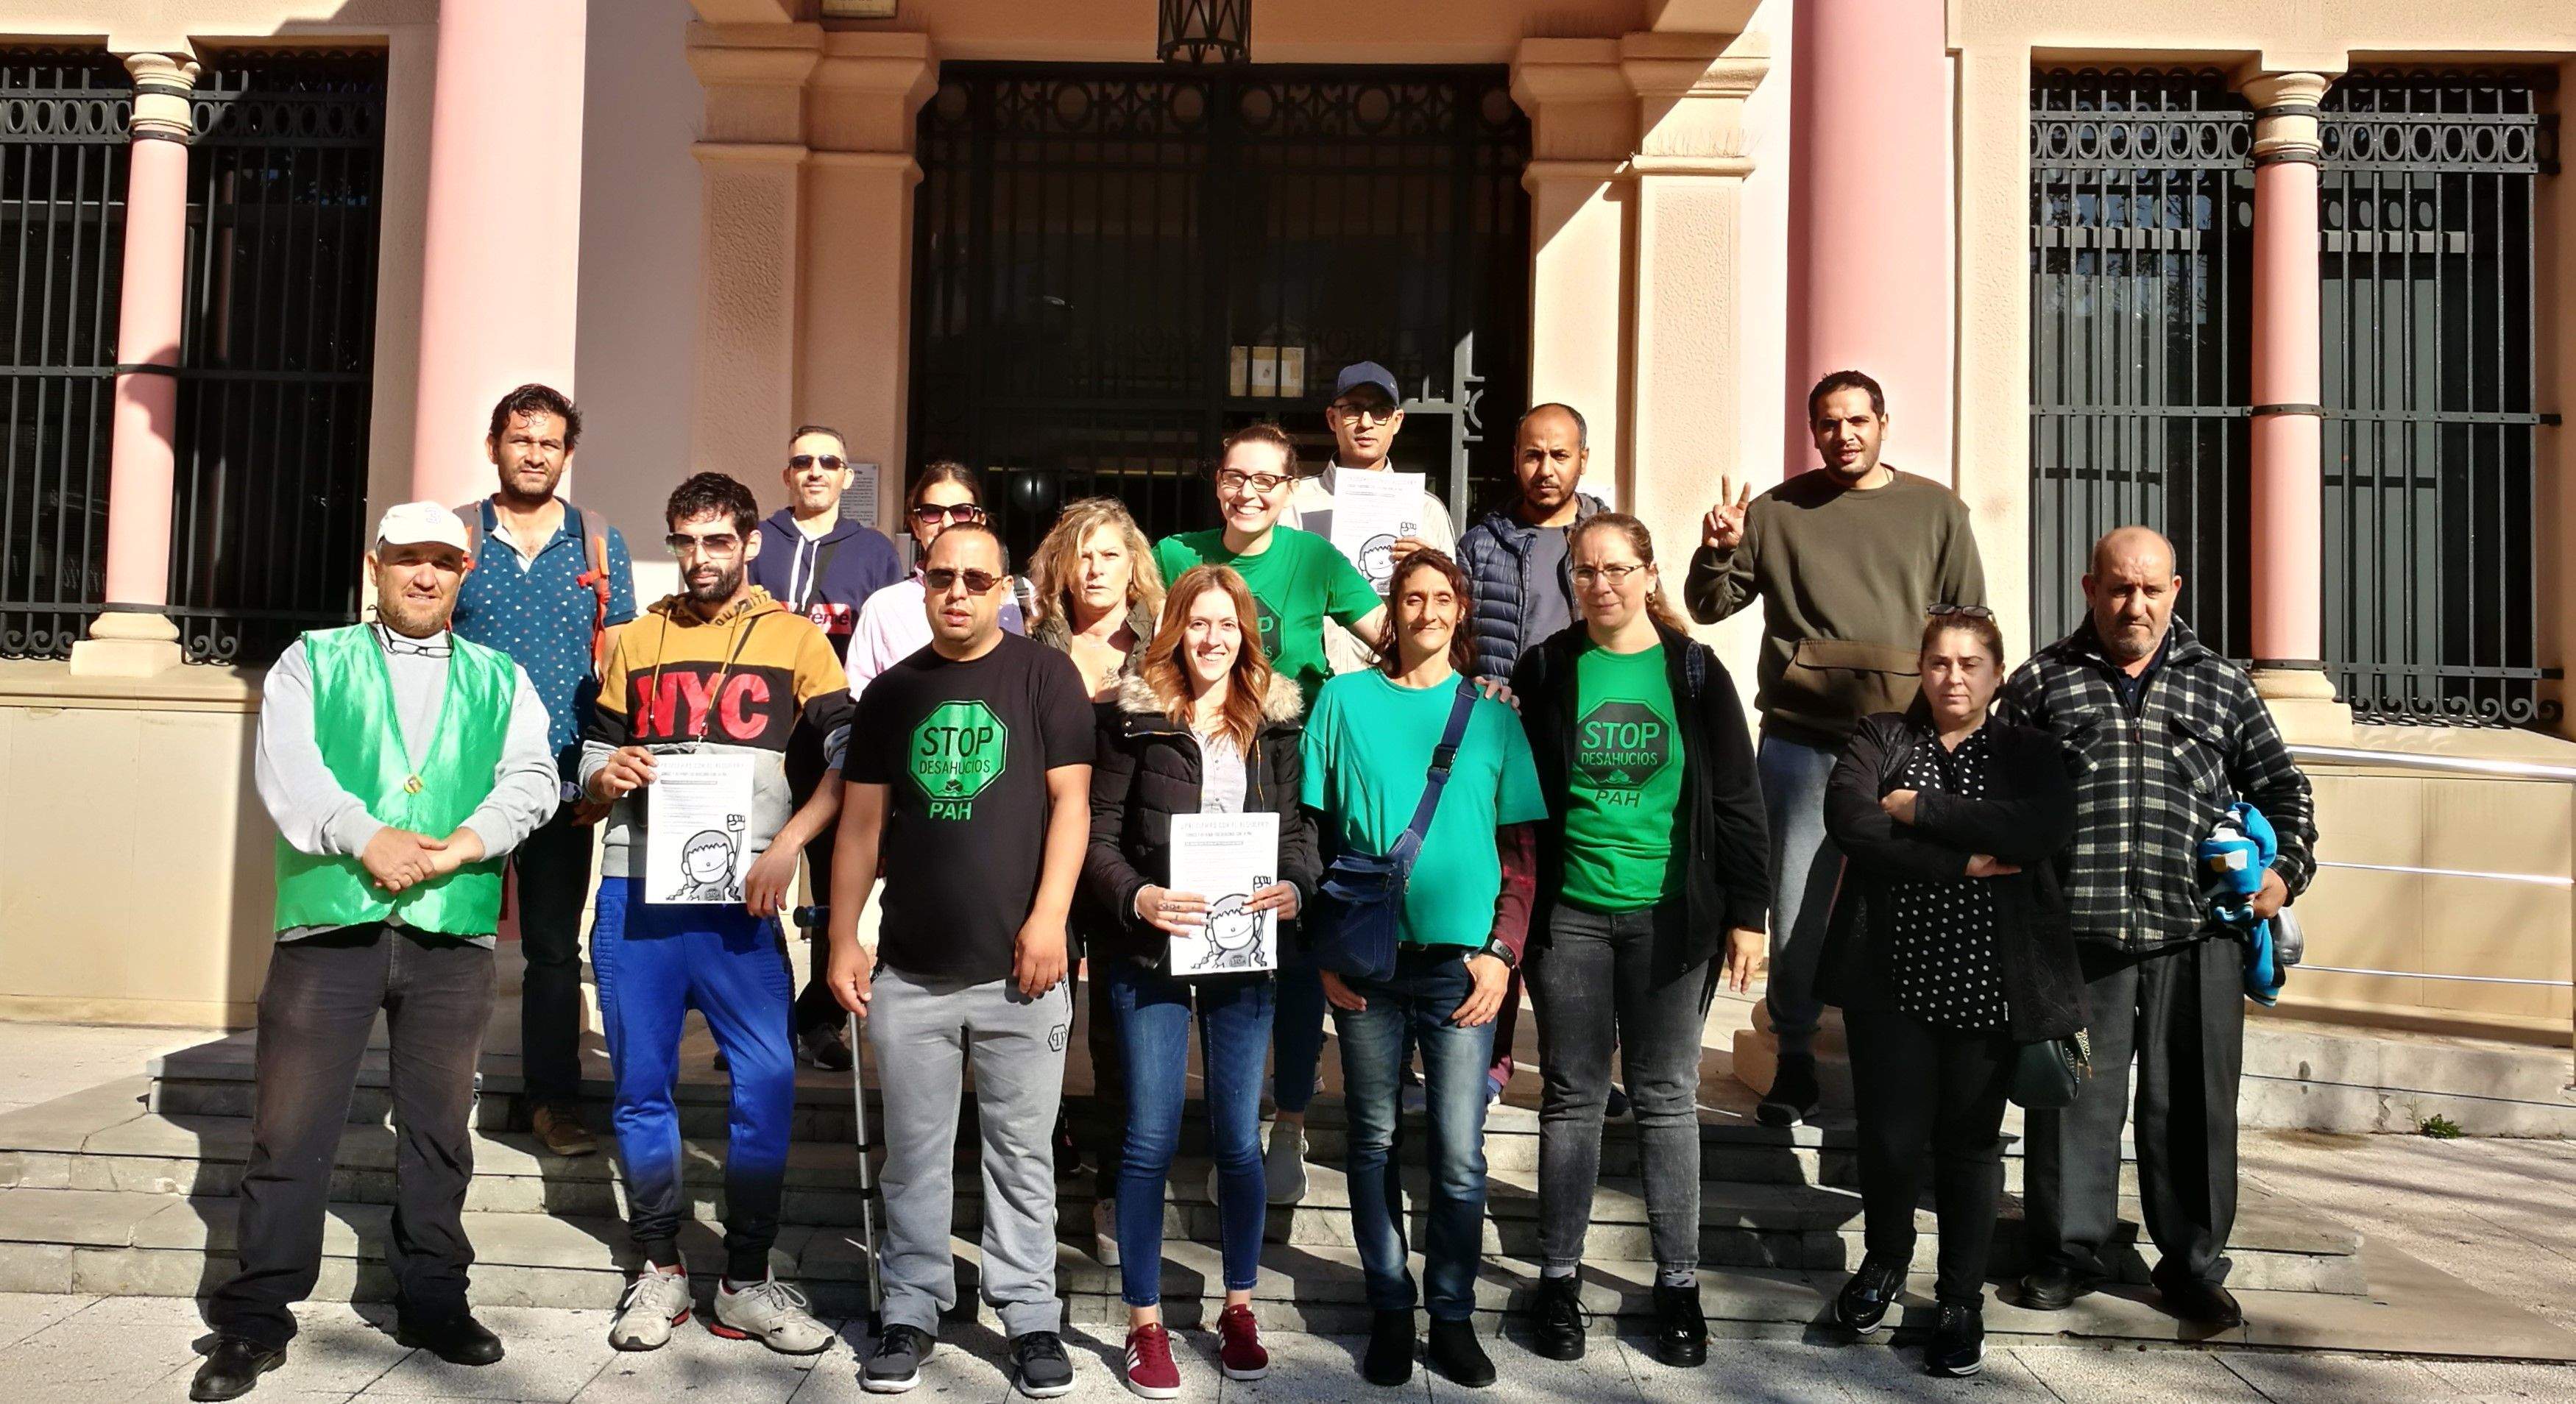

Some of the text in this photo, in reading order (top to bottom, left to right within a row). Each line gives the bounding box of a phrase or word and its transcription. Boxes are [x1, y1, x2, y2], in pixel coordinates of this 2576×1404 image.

[634, 670, 771, 740] NYC
[921, 726, 994, 757] STOP
[1582, 721, 1660, 749] STOP
[919, 759, 991, 775] DESAHUCIOS
[1581, 752, 1657, 766] DESAHUCIOS
[1595, 789, 1641, 808] PAH
[929, 801, 972, 820] PAH
